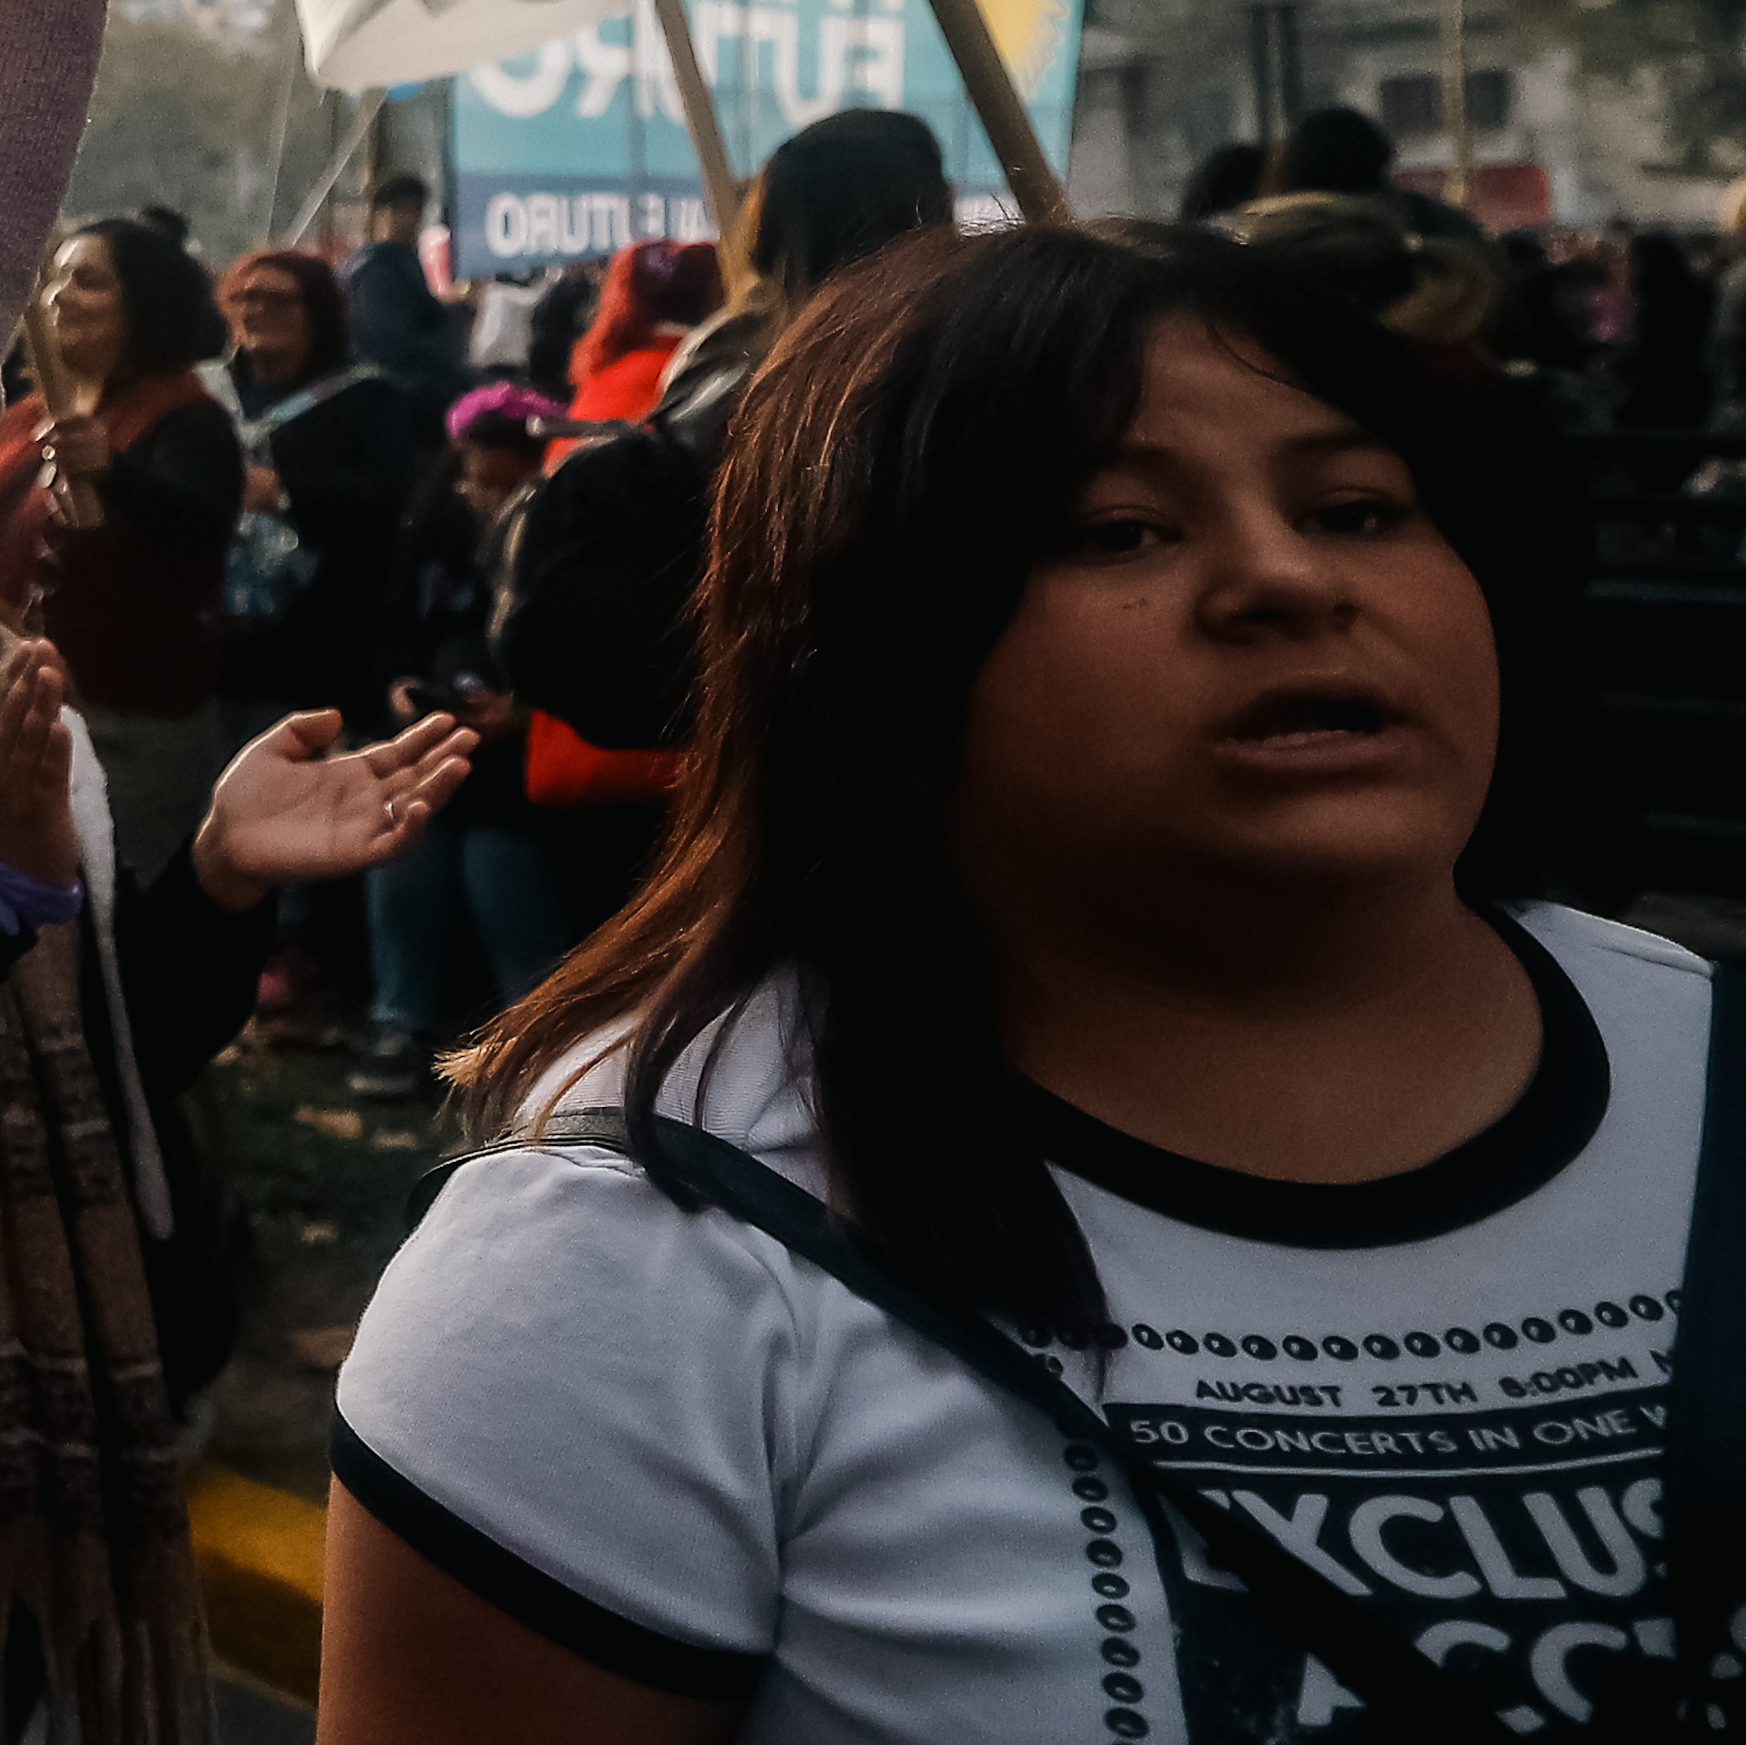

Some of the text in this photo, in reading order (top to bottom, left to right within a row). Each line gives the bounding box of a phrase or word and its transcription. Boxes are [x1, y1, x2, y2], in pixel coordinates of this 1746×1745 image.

[1196, 1378, 1343, 1409] AUGUST
[1371, 1380, 1477, 1408] 27TH
[1130, 1419, 1190, 1448] 50
[1203, 1423, 1459, 1455] CONCERTS
[1468, 1426, 1521, 1452] IN
[1532, 1408, 1638, 1446] ONE
